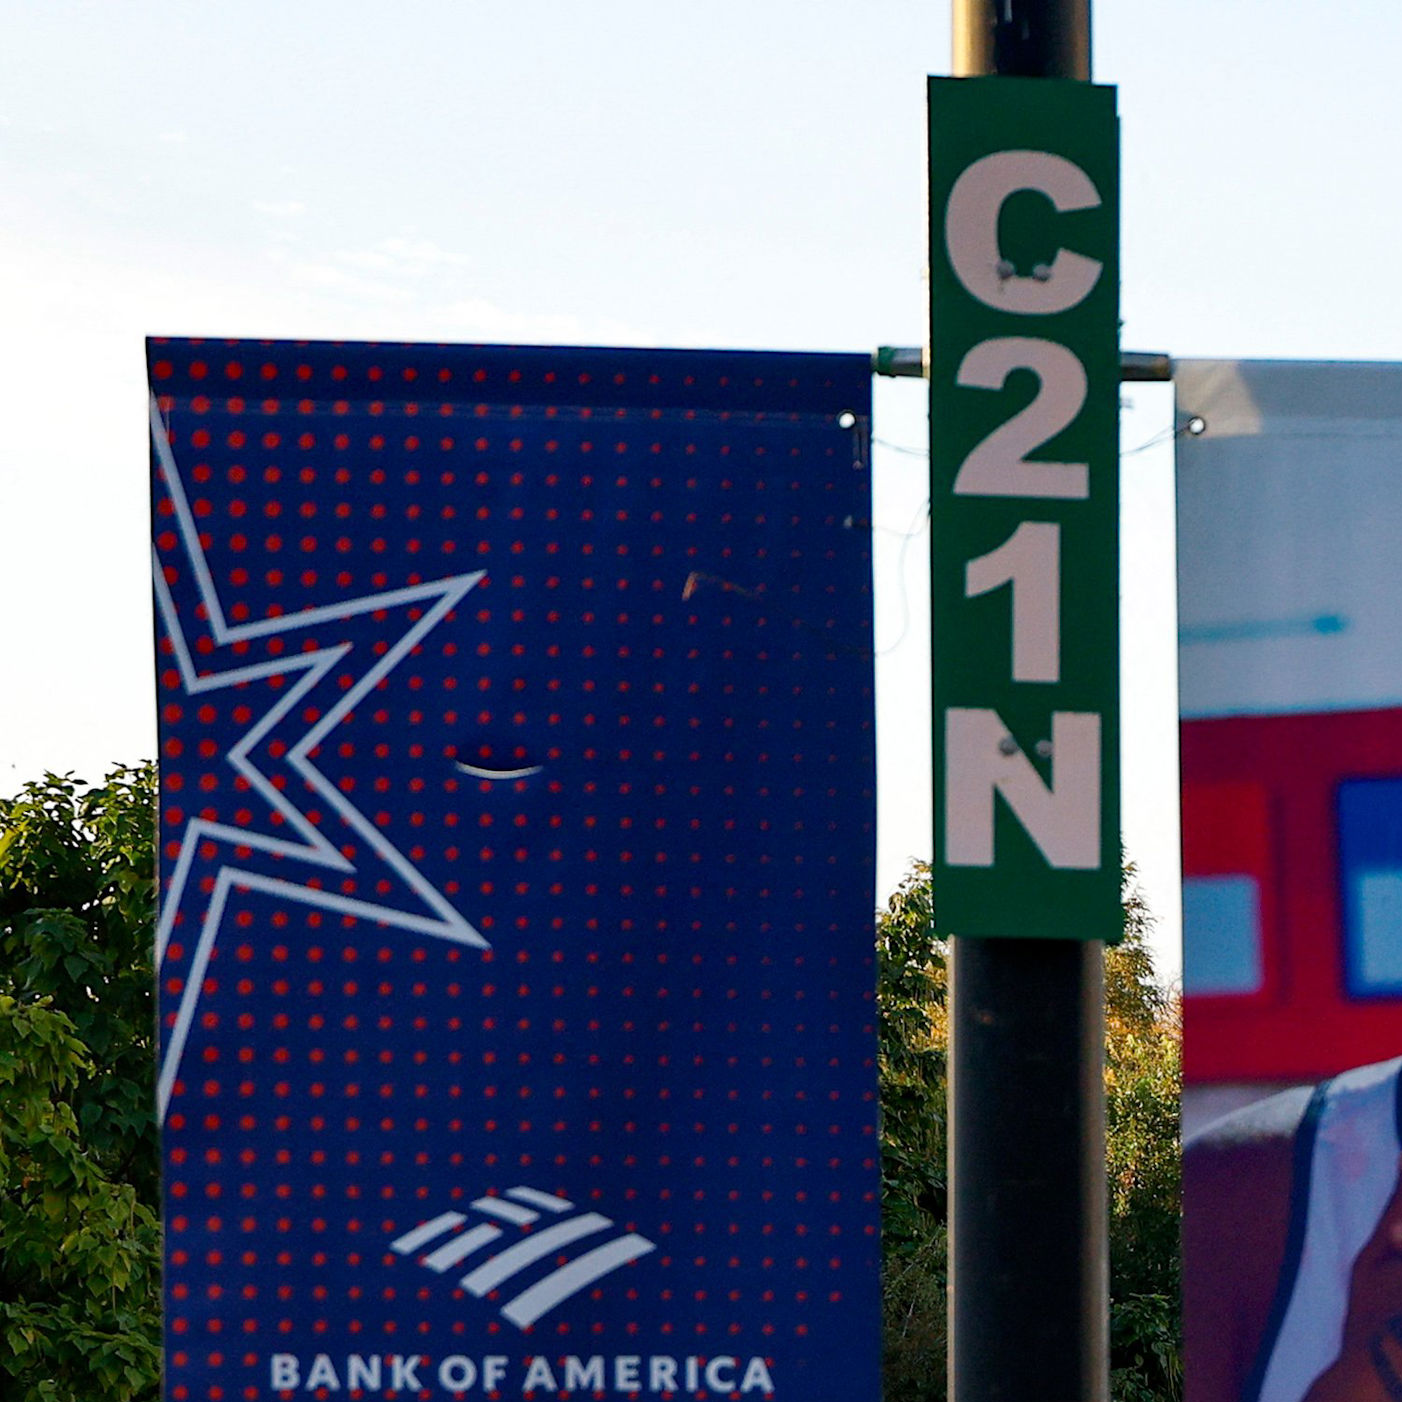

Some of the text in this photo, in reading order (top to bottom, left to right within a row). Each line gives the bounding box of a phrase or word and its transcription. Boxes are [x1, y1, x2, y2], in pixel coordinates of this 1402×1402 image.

[944, 150, 1103, 870] C21N
[270, 1354, 774, 1393] BANK OF AMERICA
